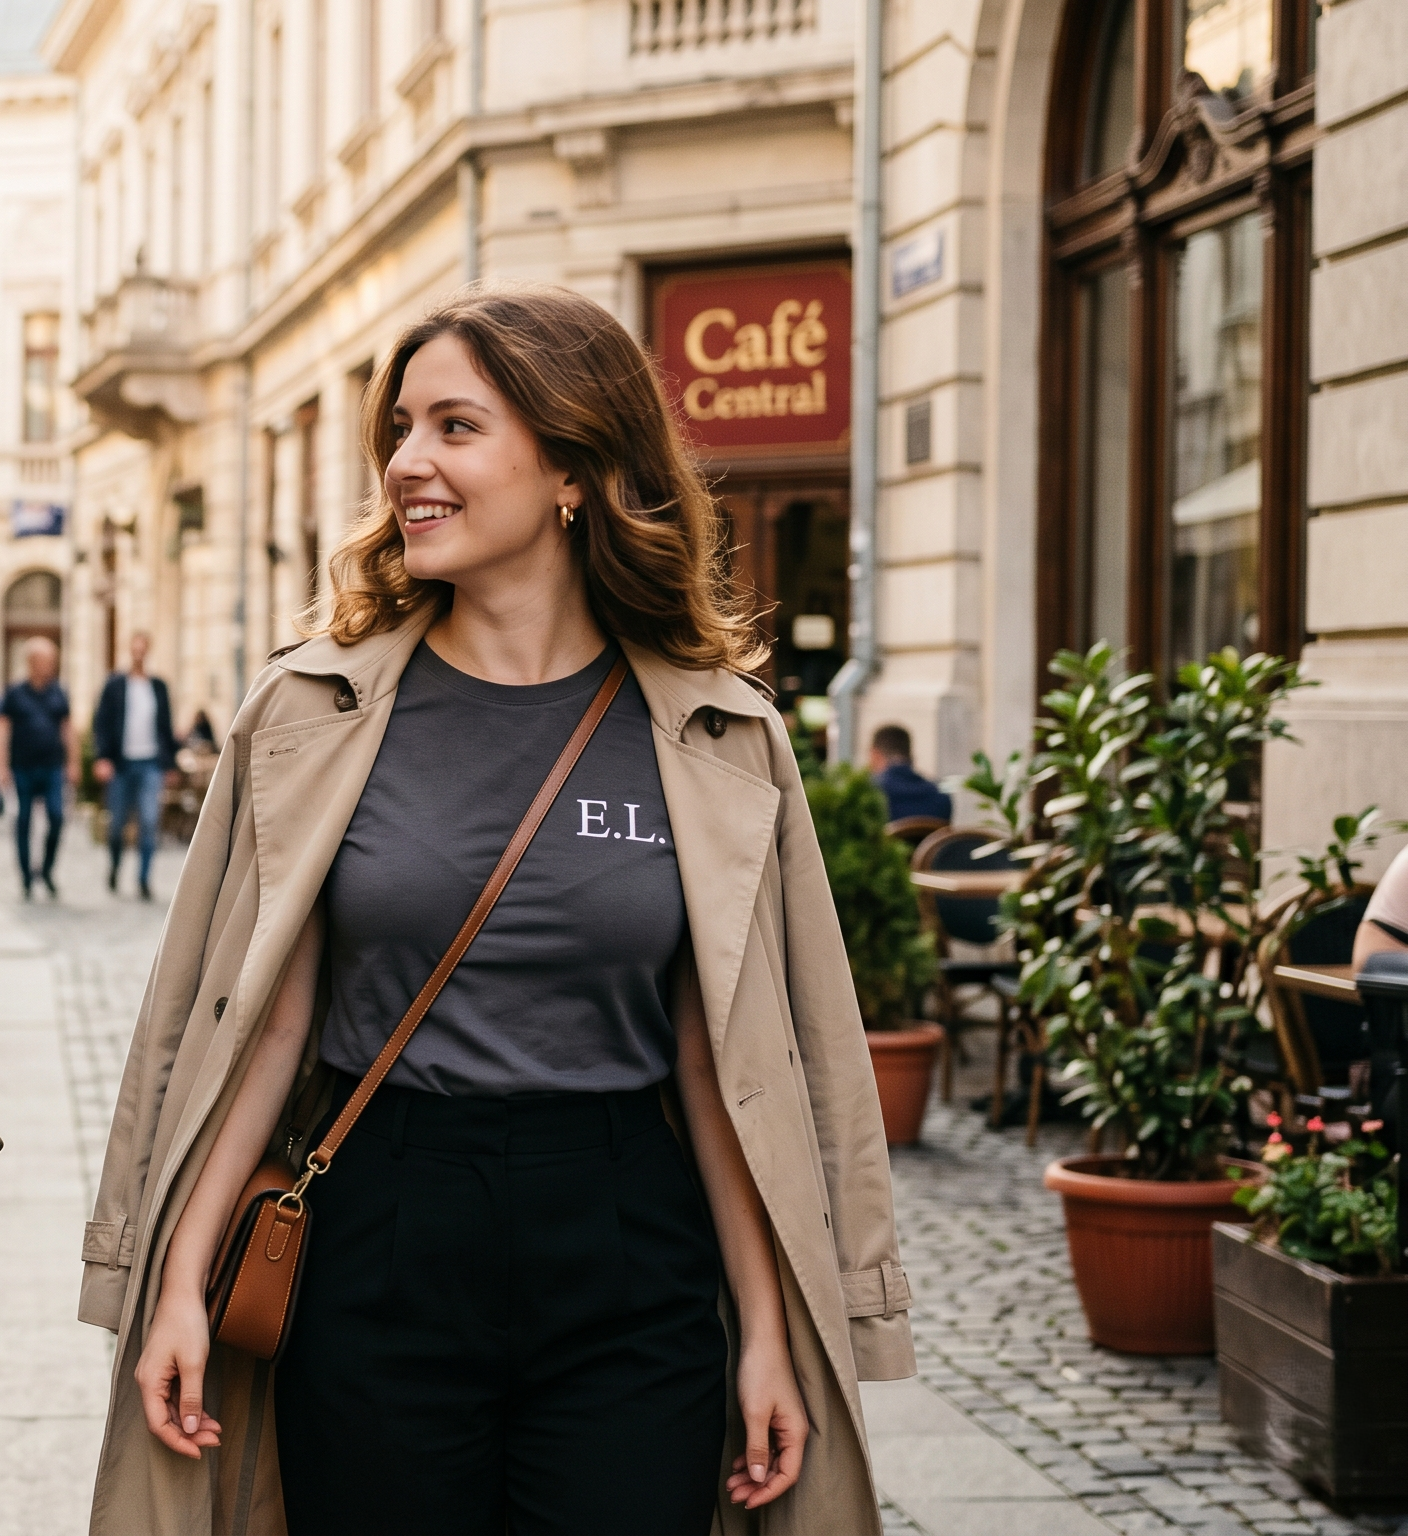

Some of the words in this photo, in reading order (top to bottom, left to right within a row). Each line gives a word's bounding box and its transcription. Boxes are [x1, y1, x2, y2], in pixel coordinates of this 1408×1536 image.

[684, 299, 828, 374] Café
[683, 370, 827, 421] Central
[576, 798, 666, 844] E.L.
